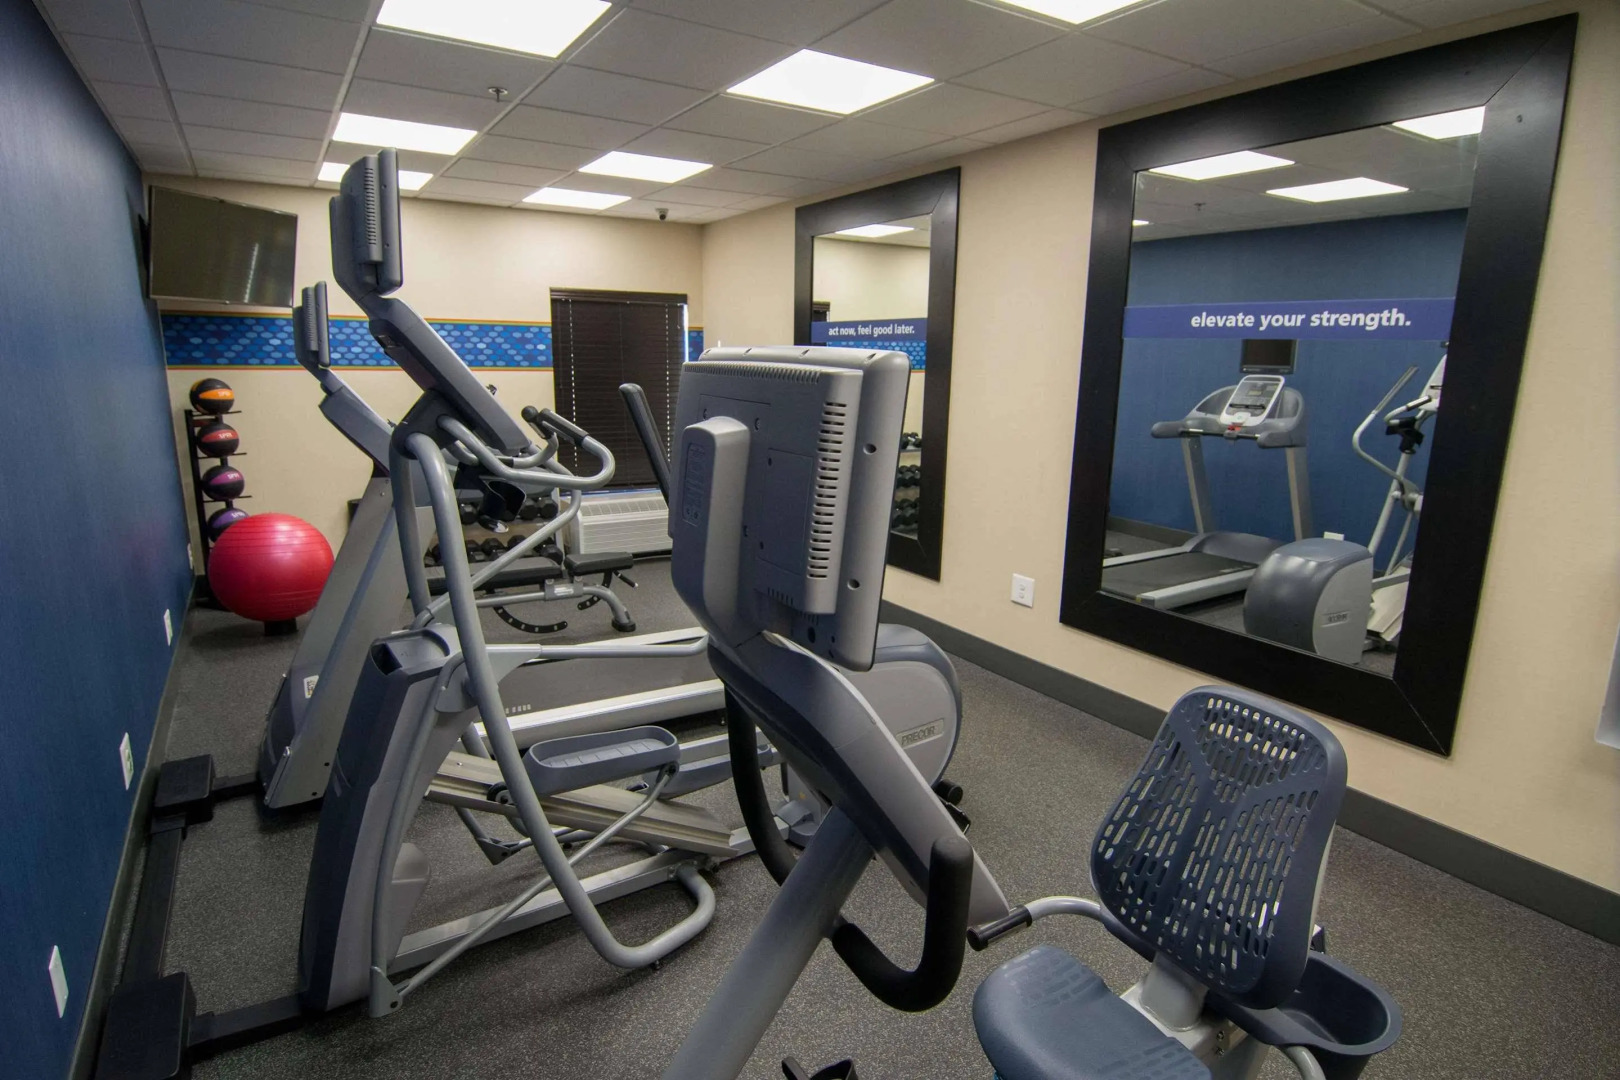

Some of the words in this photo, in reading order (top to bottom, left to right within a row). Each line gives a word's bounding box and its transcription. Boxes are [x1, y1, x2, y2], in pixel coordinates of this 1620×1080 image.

[1191, 312, 1255, 328] elevate
[1259, 313, 1306, 331] your
[1310, 308, 1411, 331] strength.
[828, 326, 839, 336] act
[840, 327, 856, 336] now,
[858, 325, 872, 335] feel
[873, 324, 893, 337] good
[894, 324, 915, 334] later.
[902, 726, 935, 745] PRECOR
